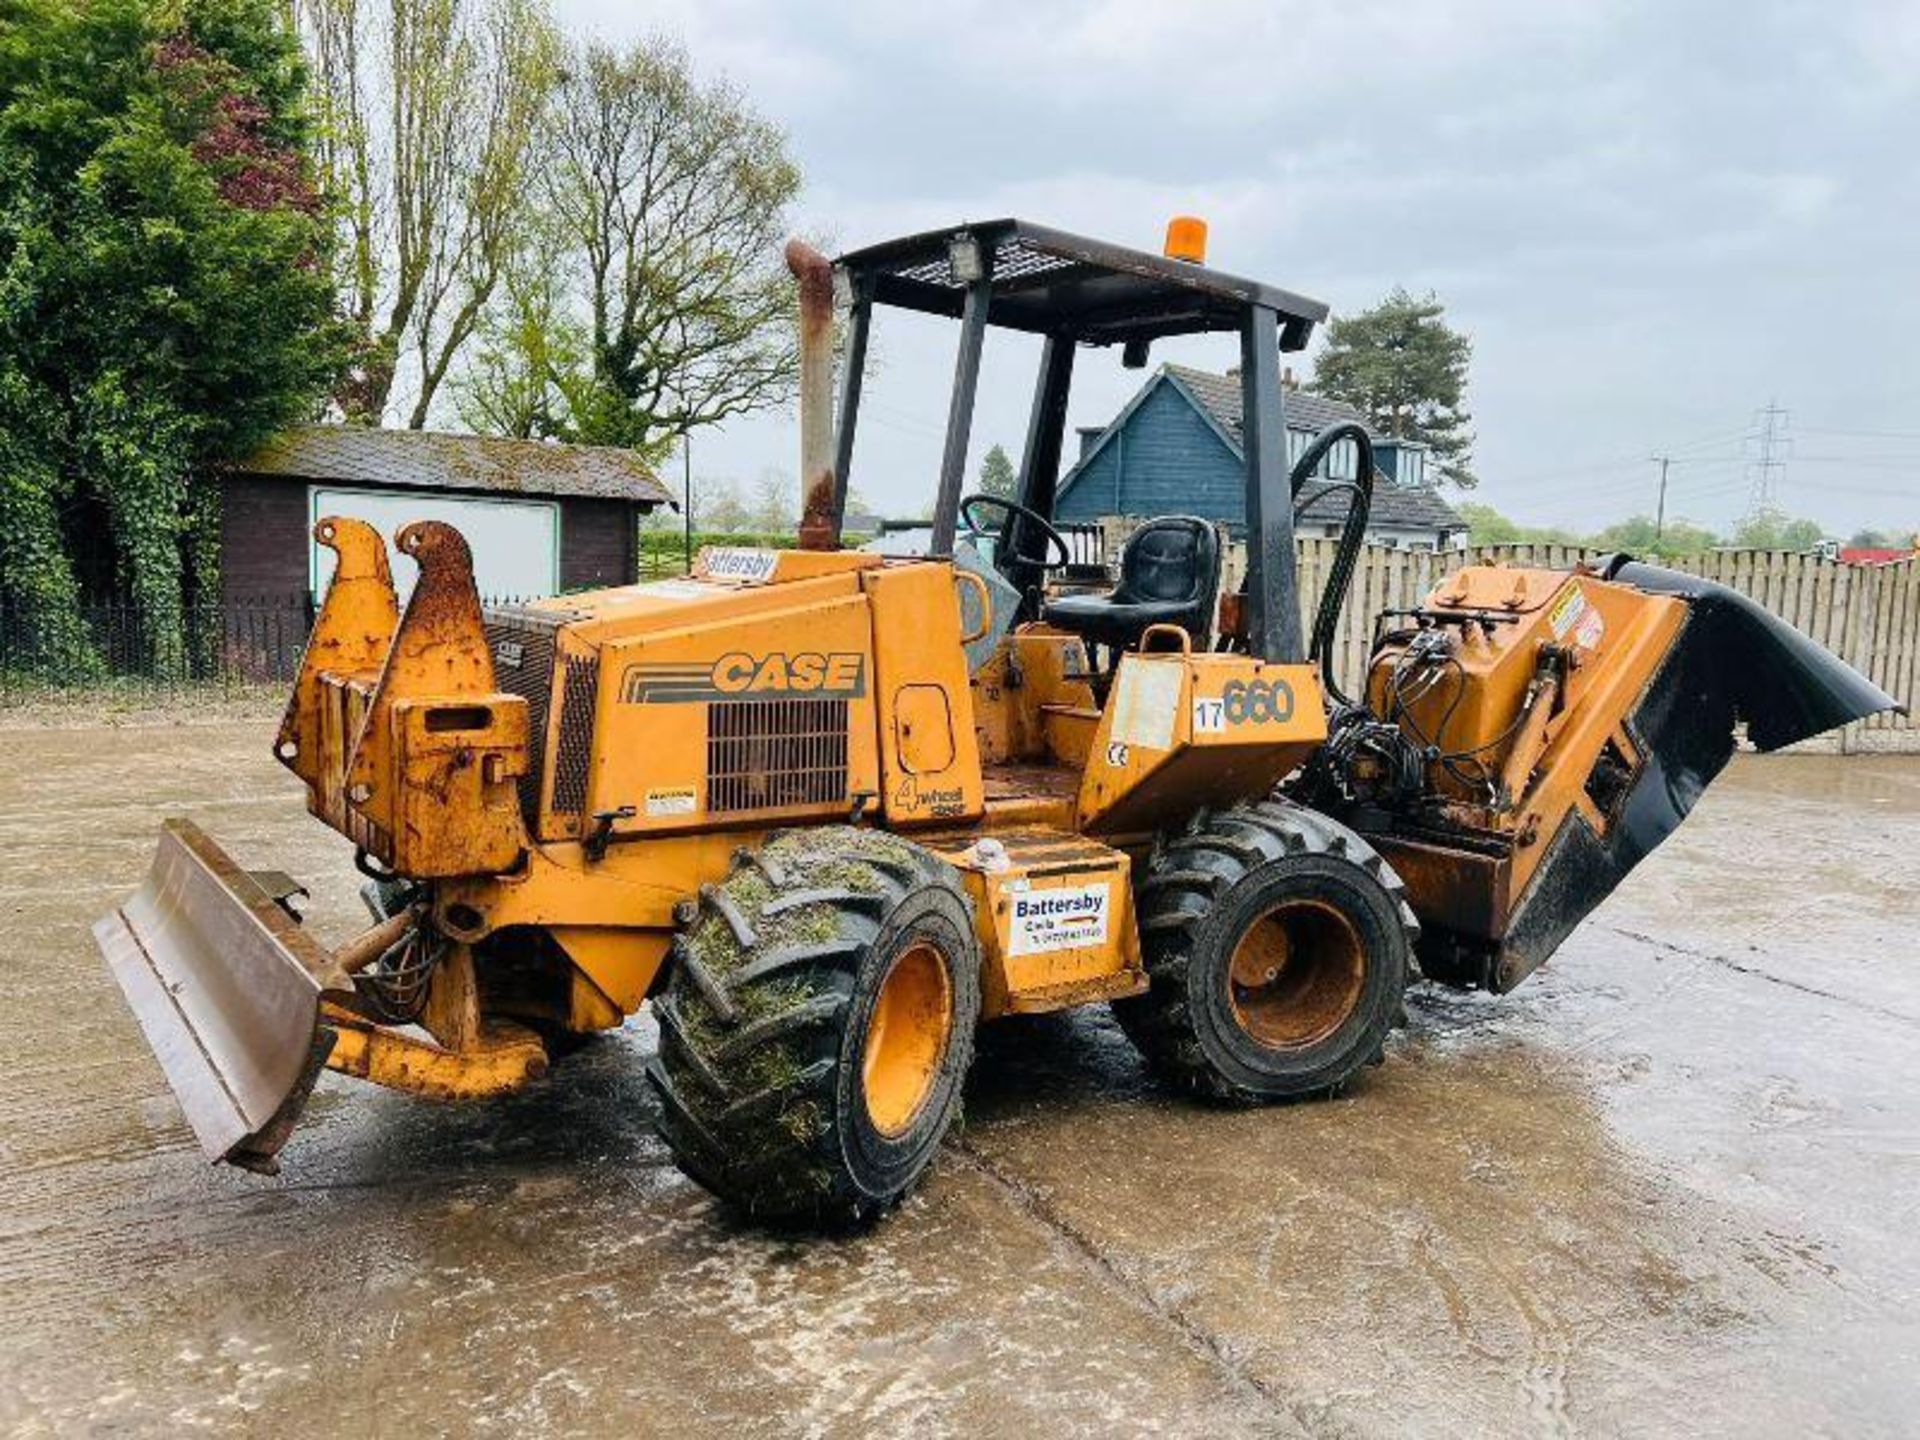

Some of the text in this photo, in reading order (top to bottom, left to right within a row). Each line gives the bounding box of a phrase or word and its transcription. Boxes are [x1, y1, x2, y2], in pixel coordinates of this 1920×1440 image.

[711, 652, 862, 693] CASE
[1195, 702, 1222, 728] 17
[1223, 679, 1294, 725] 660
[1016, 892, 1103, 918] Battersby
